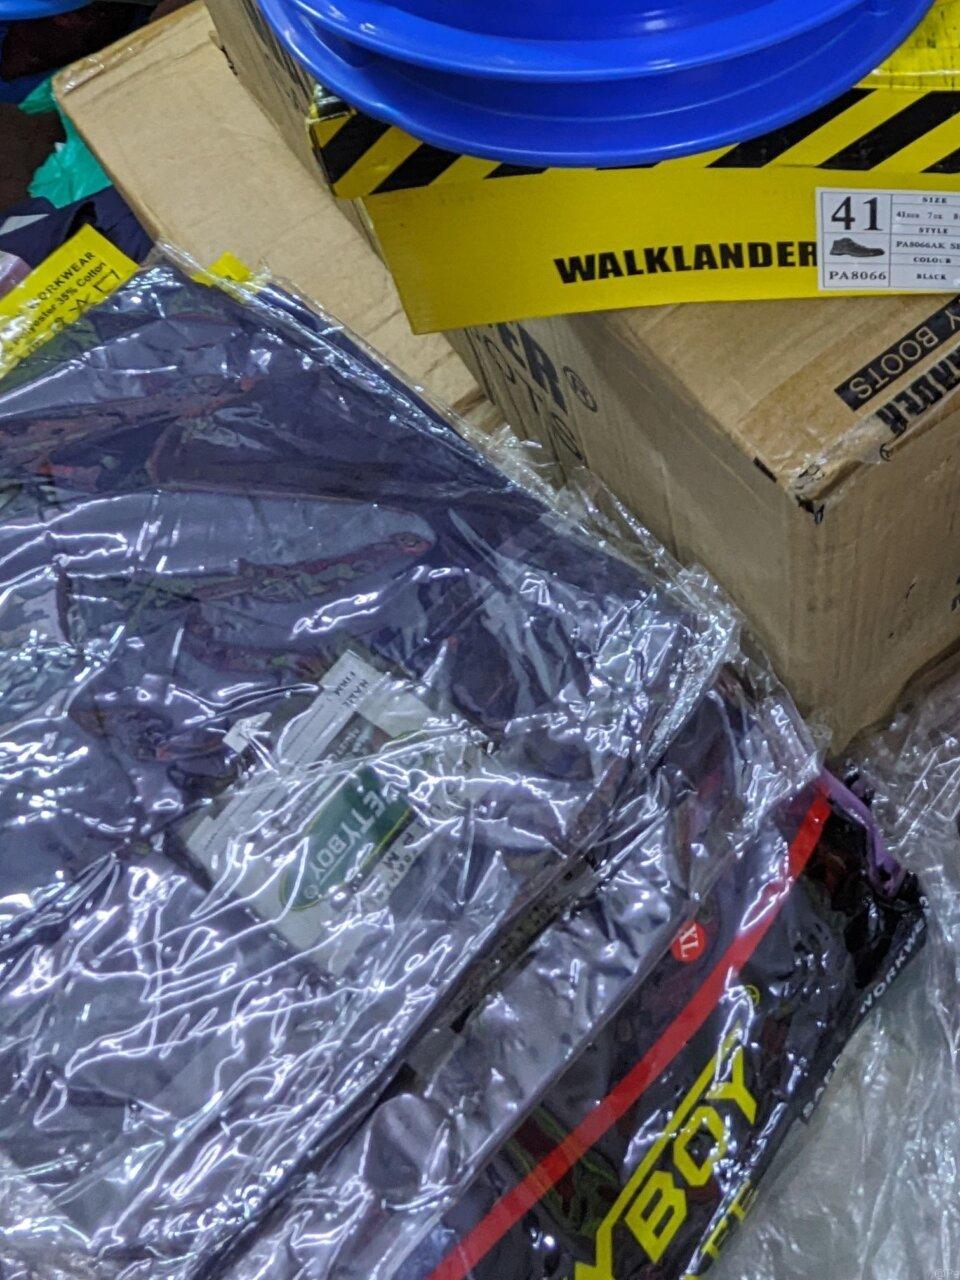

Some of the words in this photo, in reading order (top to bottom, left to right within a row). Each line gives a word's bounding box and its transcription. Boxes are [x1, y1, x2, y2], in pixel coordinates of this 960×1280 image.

[830, 195, 883, 232] 41
[922, 196, 947, 204] SIZE
[554, 241, 817, 284] WALKLANDER
[829, 271, 887, 281] PA8066
[916, 273, 947, 281] BLACK
[56, 286, 78, 306] 35%
[76, 261, 107, 288] Cotton
[848, 325, 939, 400] BOOTS
[680, 923, 701, 958] XL
